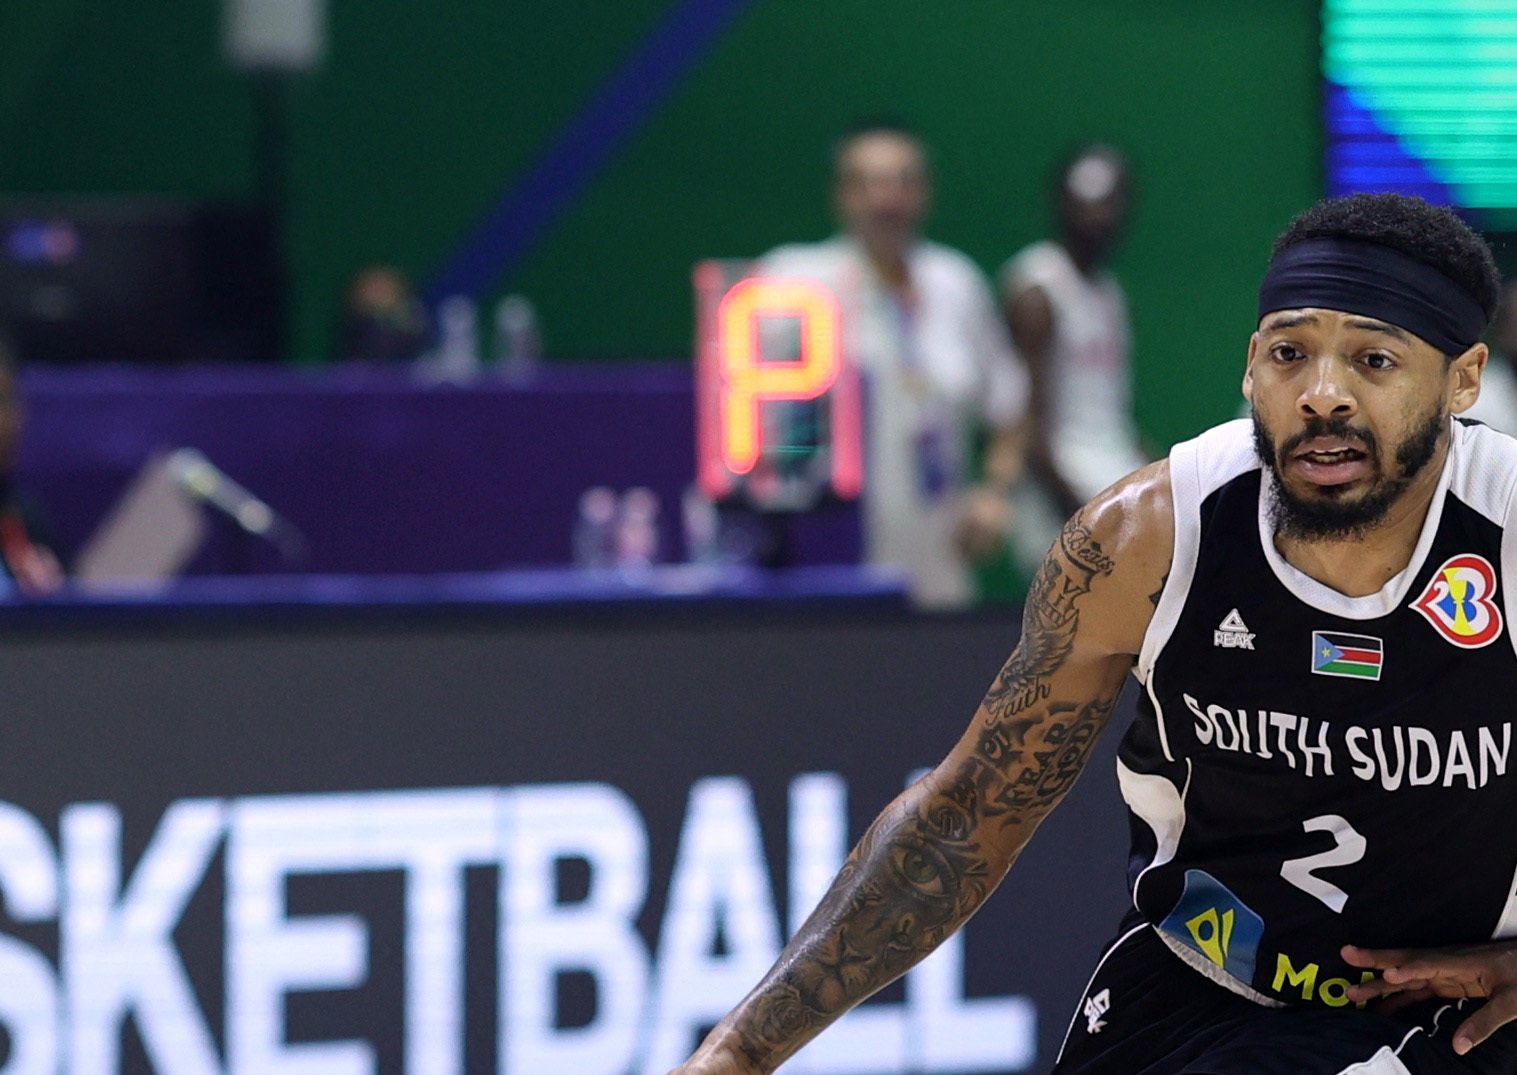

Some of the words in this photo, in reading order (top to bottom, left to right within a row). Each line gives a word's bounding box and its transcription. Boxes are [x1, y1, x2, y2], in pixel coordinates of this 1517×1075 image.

[1213, 629, 1257, 650] PEAK
[1183, 692, 1335, 778] SOUTH
[1345, 721, 1511, 792] SUDAN
[1280, 813, 1367, 914] 2
